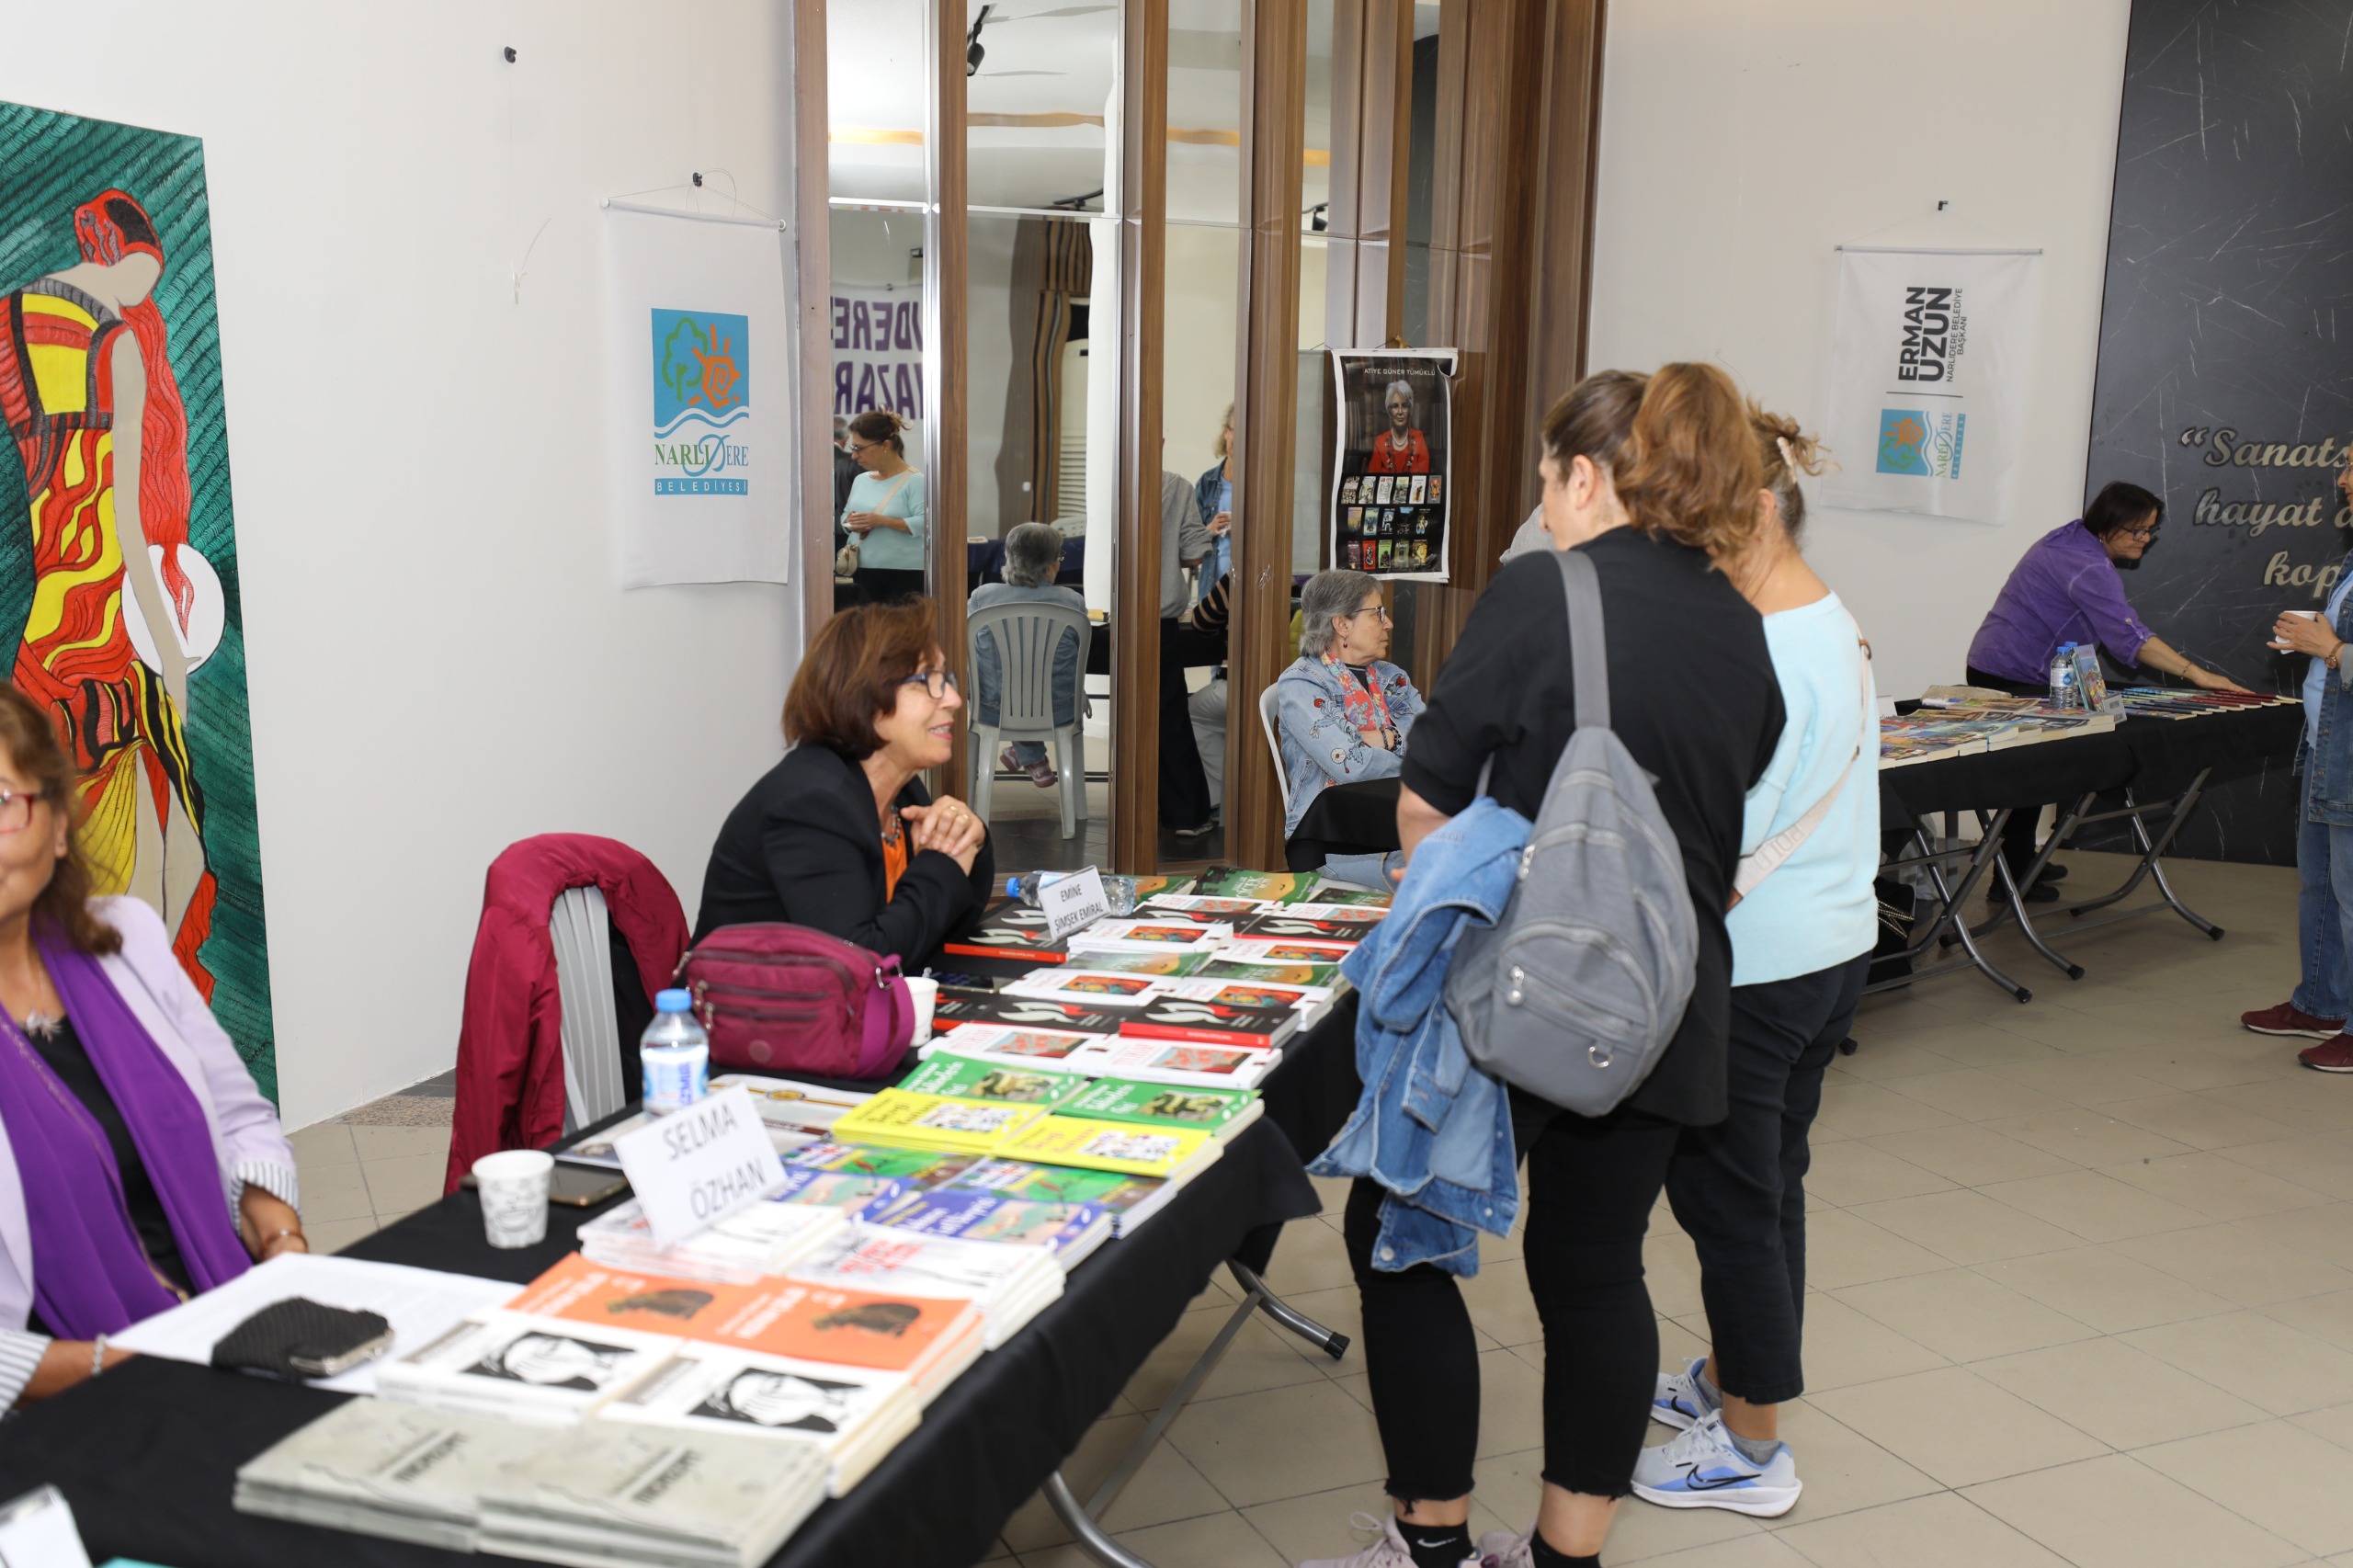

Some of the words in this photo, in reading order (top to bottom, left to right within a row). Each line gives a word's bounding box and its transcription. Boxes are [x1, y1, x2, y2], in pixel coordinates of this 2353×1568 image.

[1951, 289, 1962, 331] BELEDİYE
[1898, 287, 1926, 381] ERMAN
[1918, 288, 1952, 381] UZUN
[1946, 332, 1959, 382] NARLIDERE
[1957, 316, 1968, 355] BAŞKANI
[654, 433, 750, 478] NARLIDERE
[657, 480, 746, 493] BELEDİYESİ
[2195, 487, 2324, 538] hayat
[1060, 883, 1084, 903] EMİNE
[1054, 911, 1079, 935] ŞİMŞEK
[1078, 901, 1104, 922] EMİRAL
[662, 1103, 740, 1163] SELMA
[689, 1158, 767, 1221] ÖZHAN
